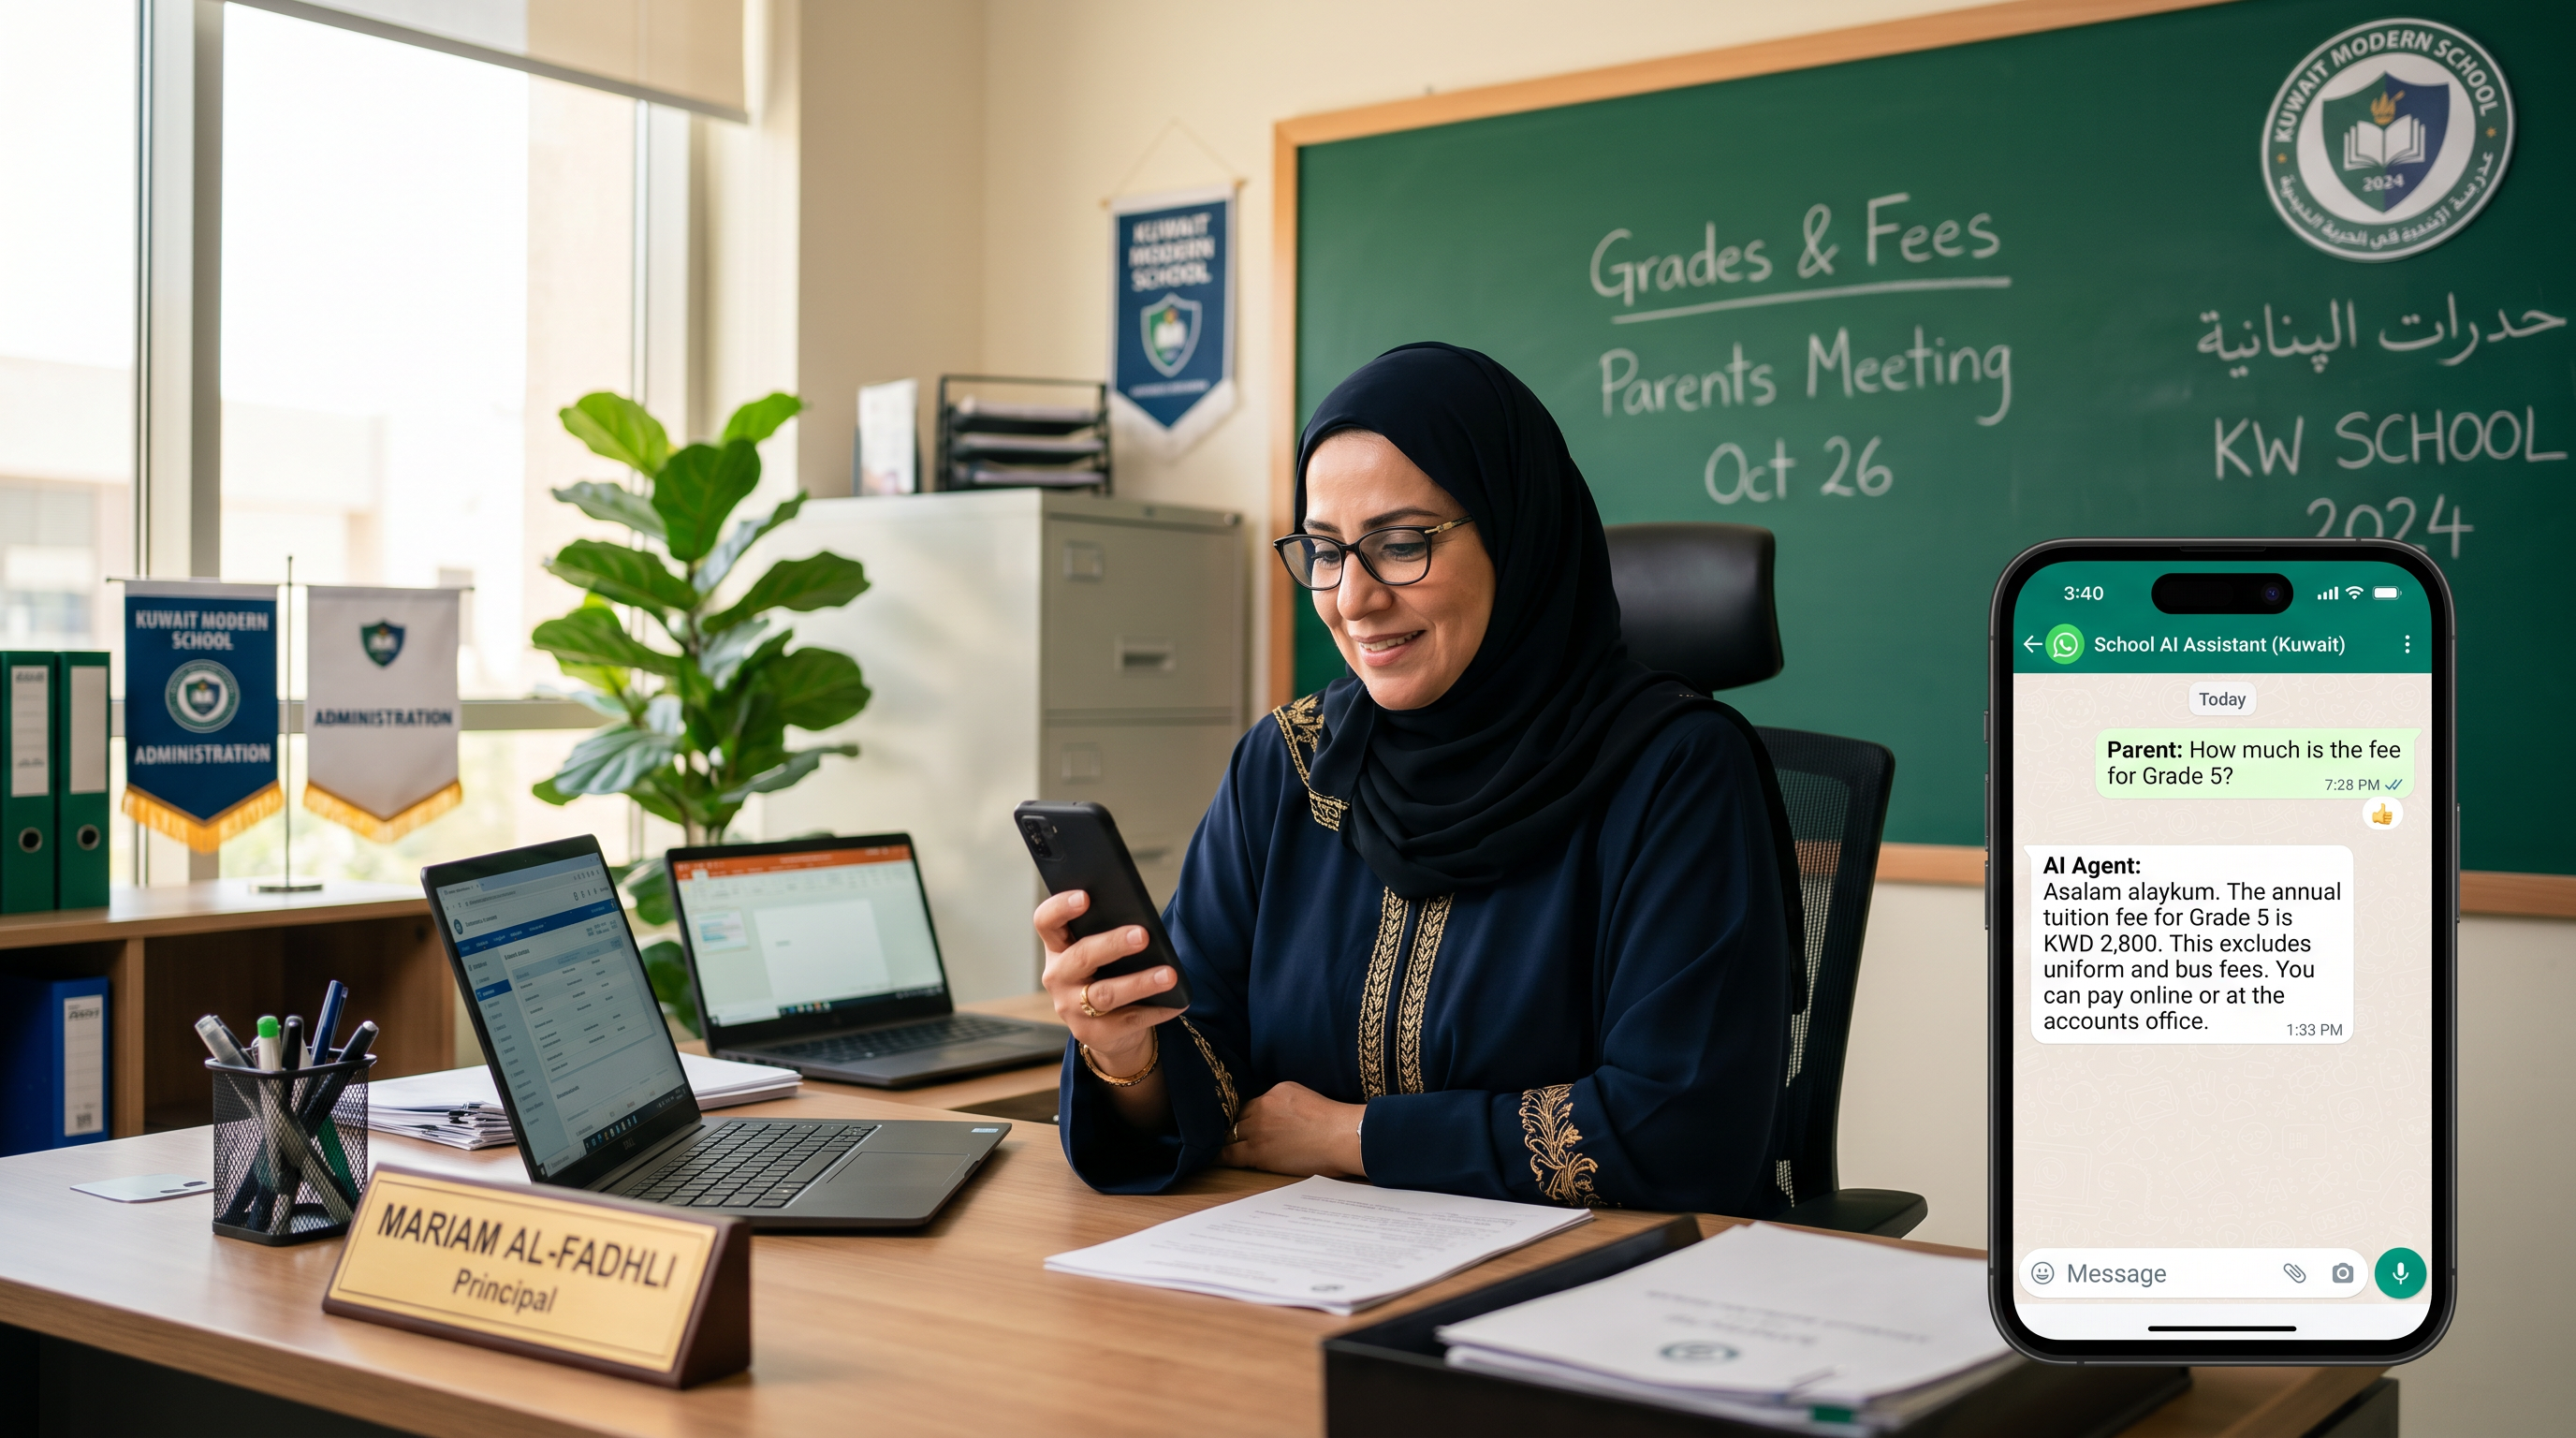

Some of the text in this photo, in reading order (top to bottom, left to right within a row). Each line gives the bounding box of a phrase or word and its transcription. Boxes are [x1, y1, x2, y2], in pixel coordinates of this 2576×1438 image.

[2275, 29, 2498, 142] KUWAIT MODERN SCHOOL
[2363, 174, 2405, 192] 2024
[1590, 192, 2002, 307] Grades & Fees
[1599, 325, 2011, 426] Parents Meeting
[2216, 404, 2569, 480] KW SCHOOL
[1705, 435, 1893, 505] Oct 26
[2306, 493, 2474, 560] 2024
[2064, 585, 2104, 601] 3:40
[136, 609, 269, 631] KUWAIT MODERN
[171, 631, 234, 651] SCHOOL
[2094, 635, 2346, 656] School AI Assistant (Kuwait)
[2199, 691, 2247, 710] Today
[314, 709, 453, 726] ADMINISTRATION
[134, 744, 271, 765] ADMINISTRATION
[2108, 739, 2401, 759] Parent: How much is the fee
[2108, 766, 2233, 785] for Grade 5?
[2324, 779, 2380, 791] 7:28 PM
[2042, 856, 2141, 878] AI Agent:
[2043, 881, 2341, 906] Asalam alaykum. The annual
[2043, 906, 2292, 927] tuition fee for Grade 5 is
[2044, 932, 2311, 956] KWD 2,800. This excludes
[2044, 959, 2315, 978] uniform and bus fees. You
[2043, 985, 2285, 1008] can pay online or at the
[2043, 1010, 2208, 1031] accounts office.
[2287, 1023, 2343, 1036] 1:33 PM
[377, 1203, 679, 1289] MARIAM AL-FADHLI
[2068, 1264, 2167, 1288] Message
[453, 1268, 558, 1313] Principal
